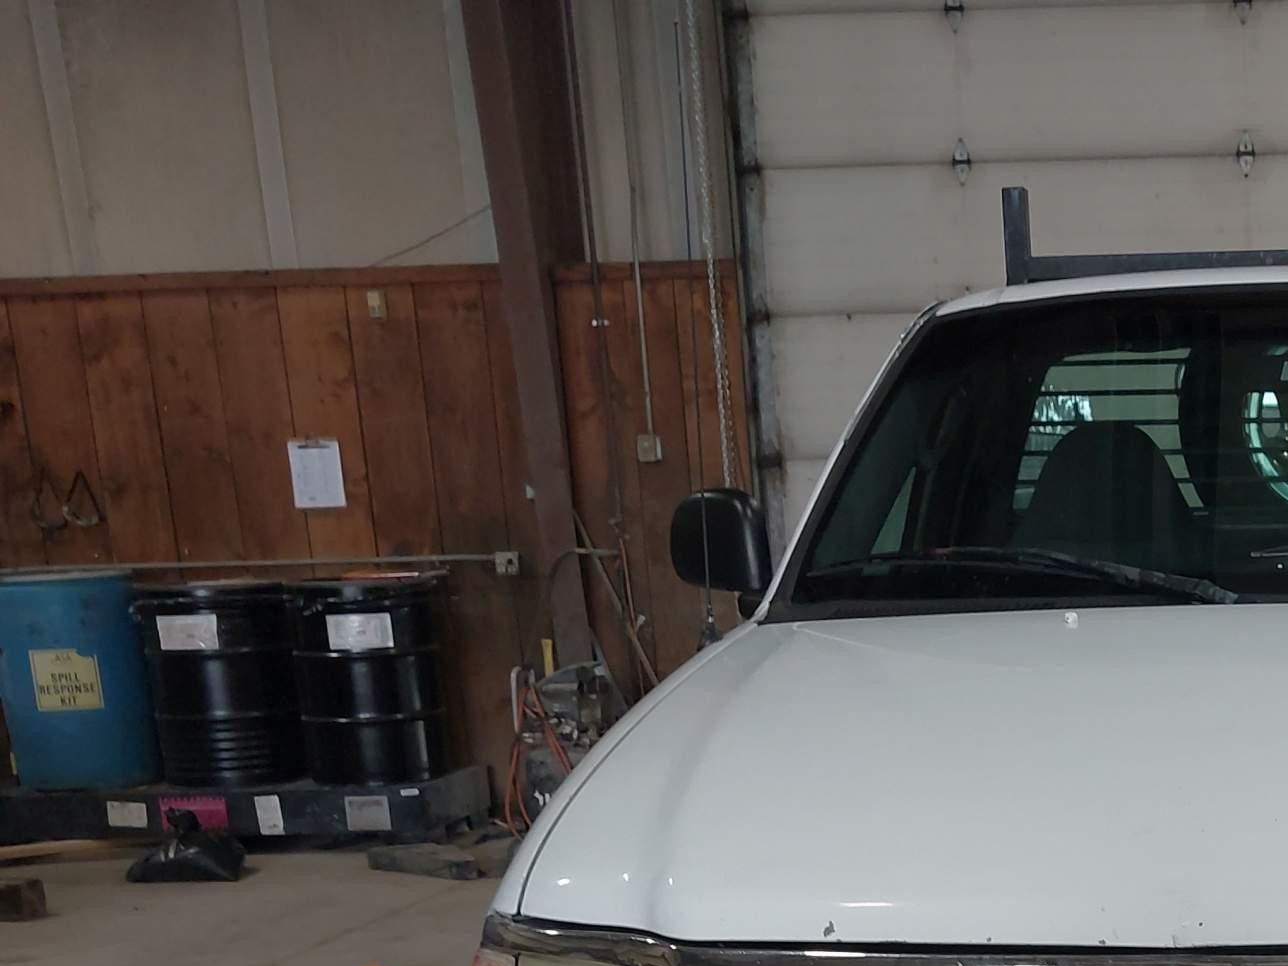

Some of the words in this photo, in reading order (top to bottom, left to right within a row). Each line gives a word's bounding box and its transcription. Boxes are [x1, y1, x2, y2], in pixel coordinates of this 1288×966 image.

[50, 671, 79, 683] SPILL
[39, 681, 97, 696] RESPONSE
[60, 694, 77, 706] KIT
